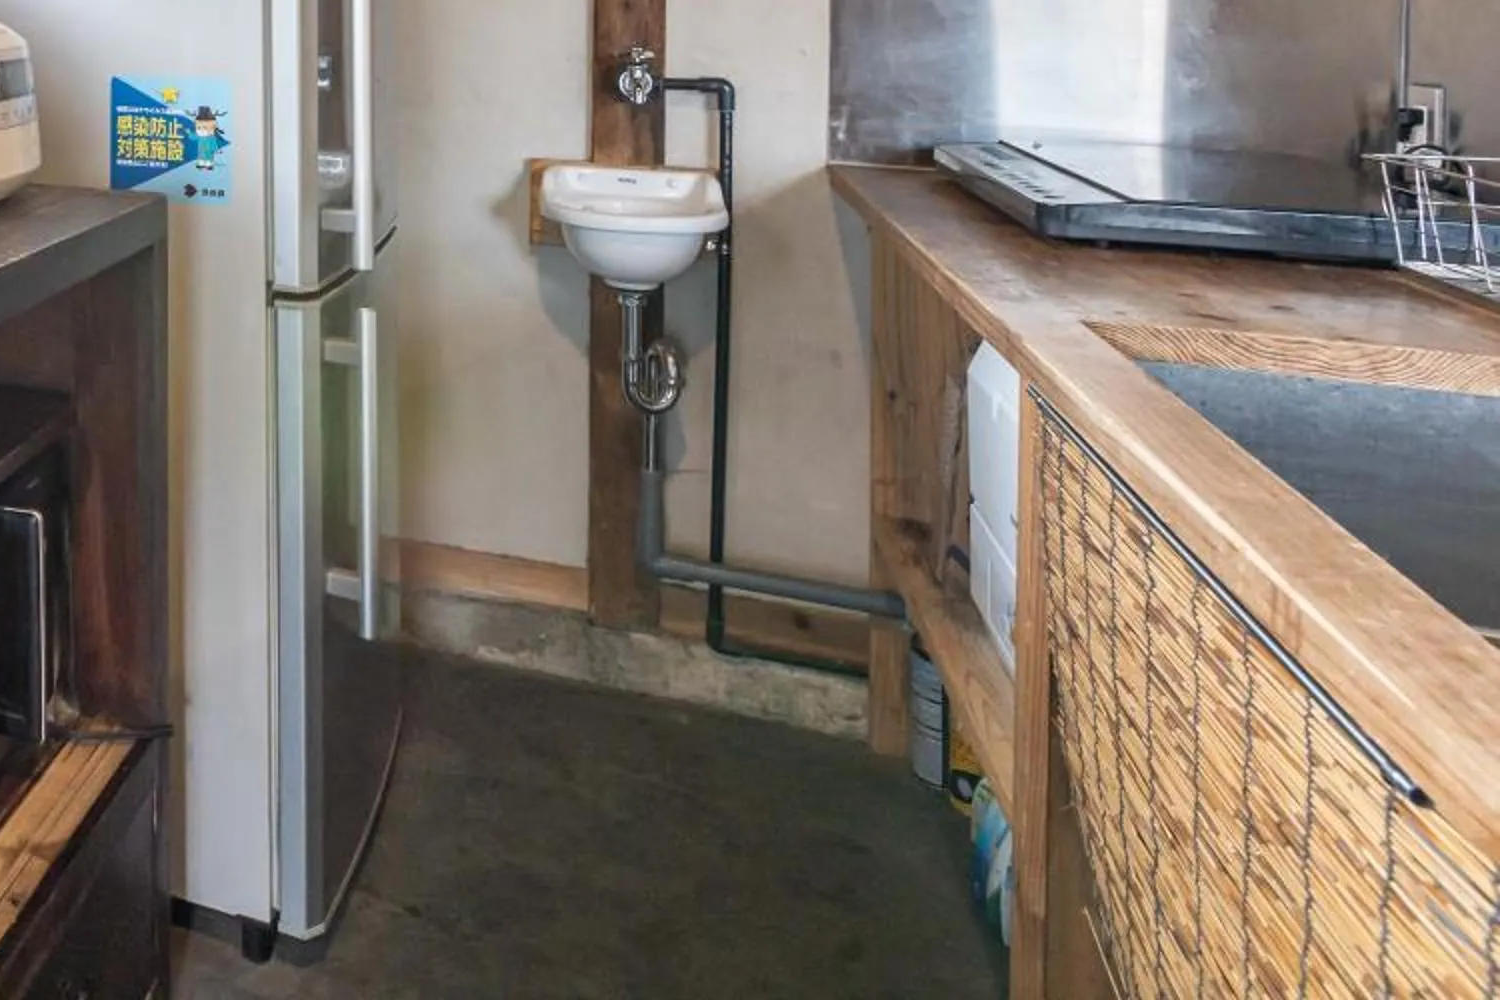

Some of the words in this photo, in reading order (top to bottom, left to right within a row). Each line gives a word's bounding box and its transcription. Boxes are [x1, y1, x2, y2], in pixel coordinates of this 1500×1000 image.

[117, 115, 185, 139] 感染防止
[117, 138, 185, 161] 対策施設
